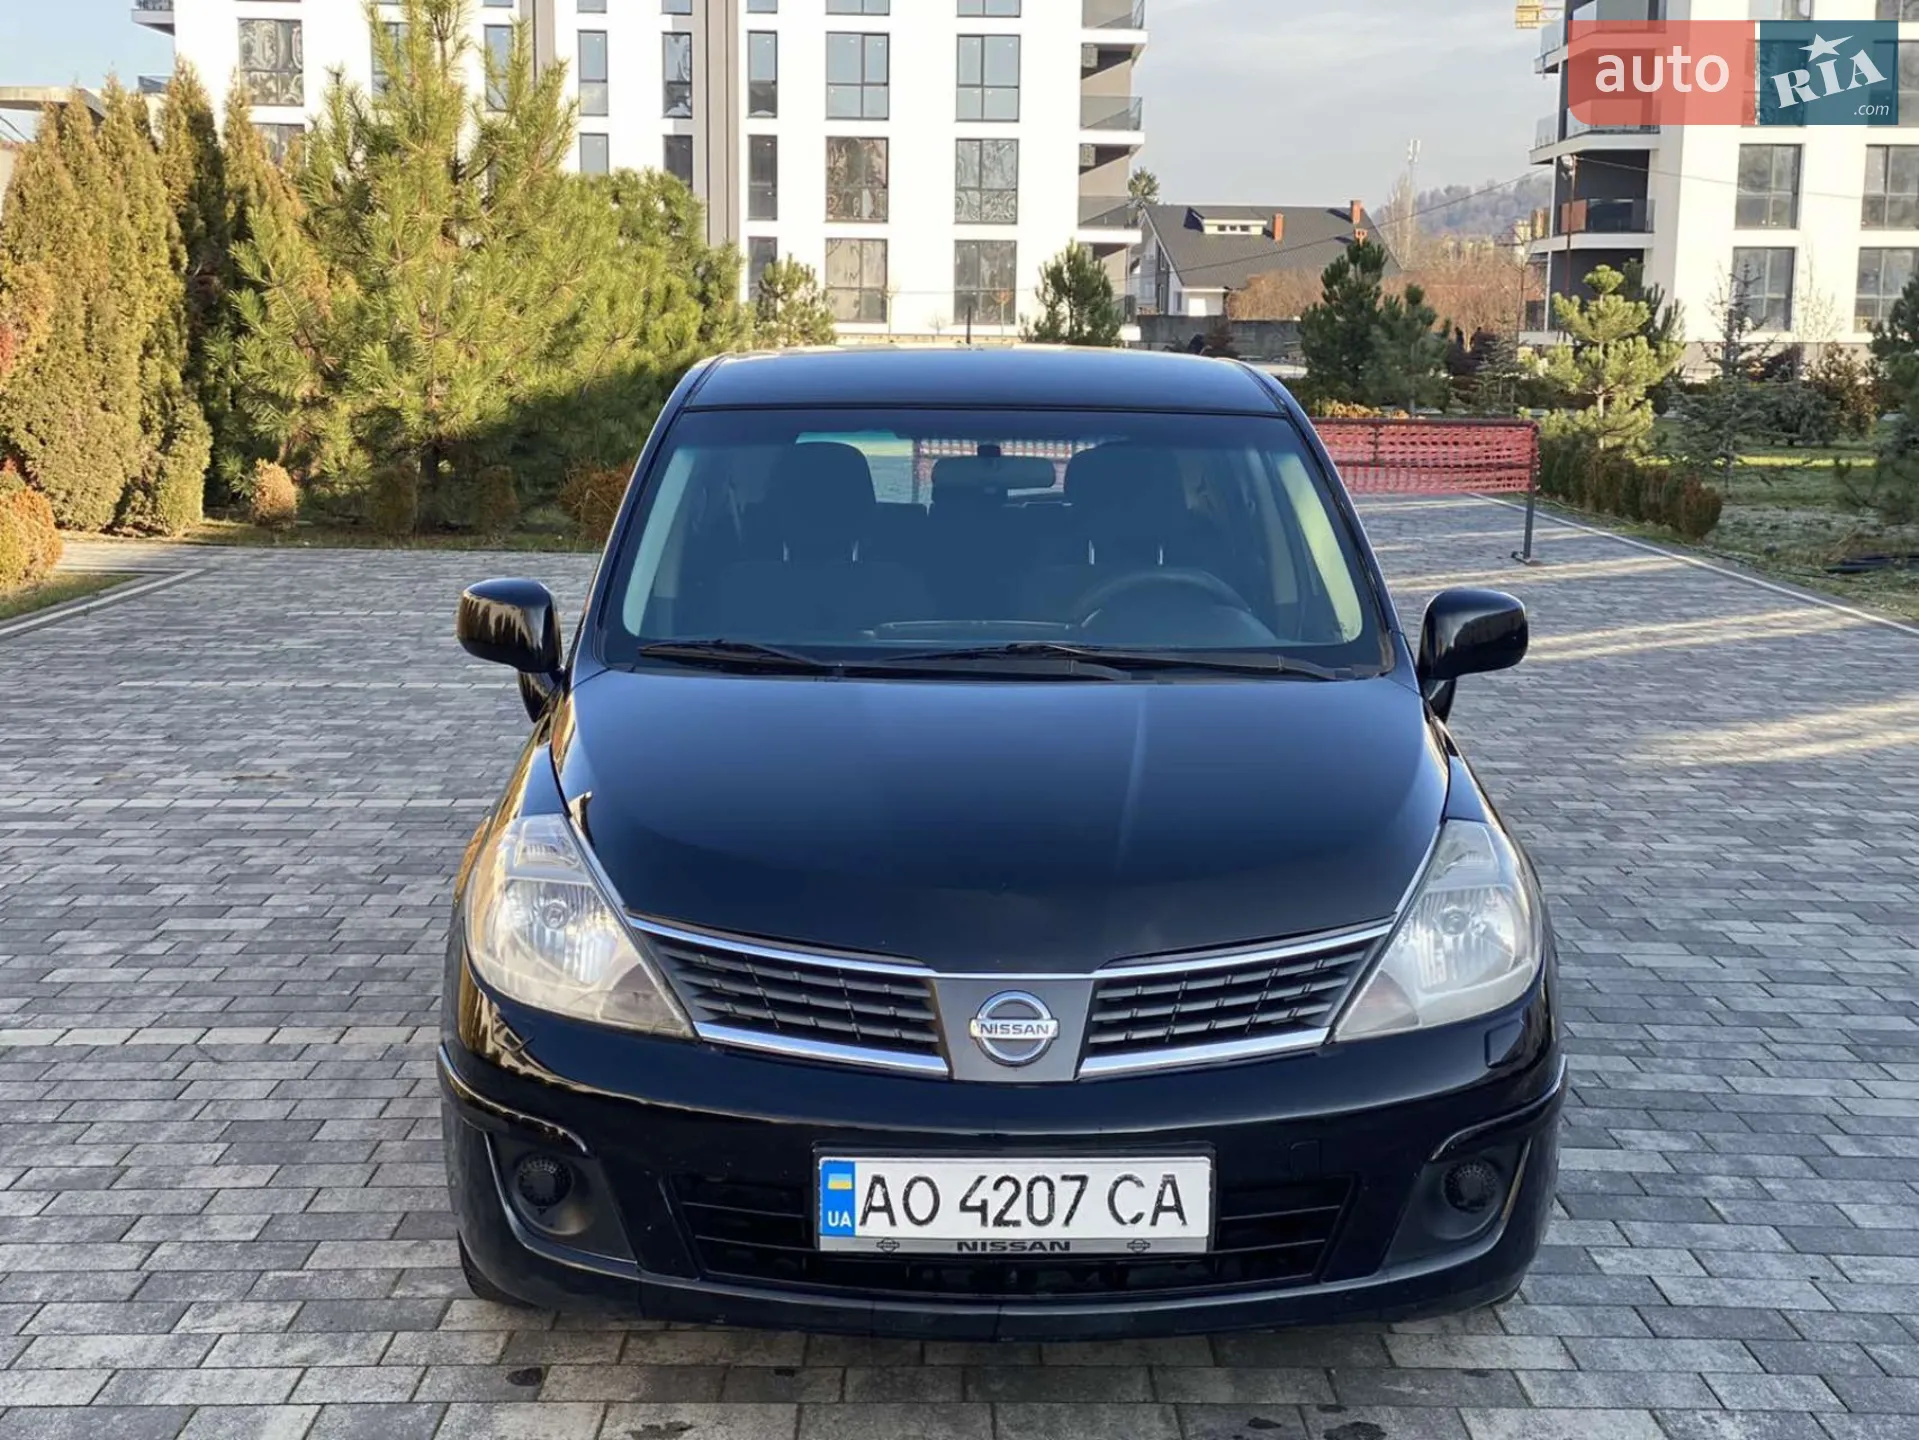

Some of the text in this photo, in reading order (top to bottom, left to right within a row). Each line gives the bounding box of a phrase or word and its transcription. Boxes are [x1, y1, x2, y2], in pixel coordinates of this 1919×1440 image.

[980, 1024, 1049, 1035] NISSAN
[859, 1174, 1188, 1227] AO 4207 CA
[828, 1212, 852, 1228] UA
[957, 1240, 1071, 1252] NISSAN
